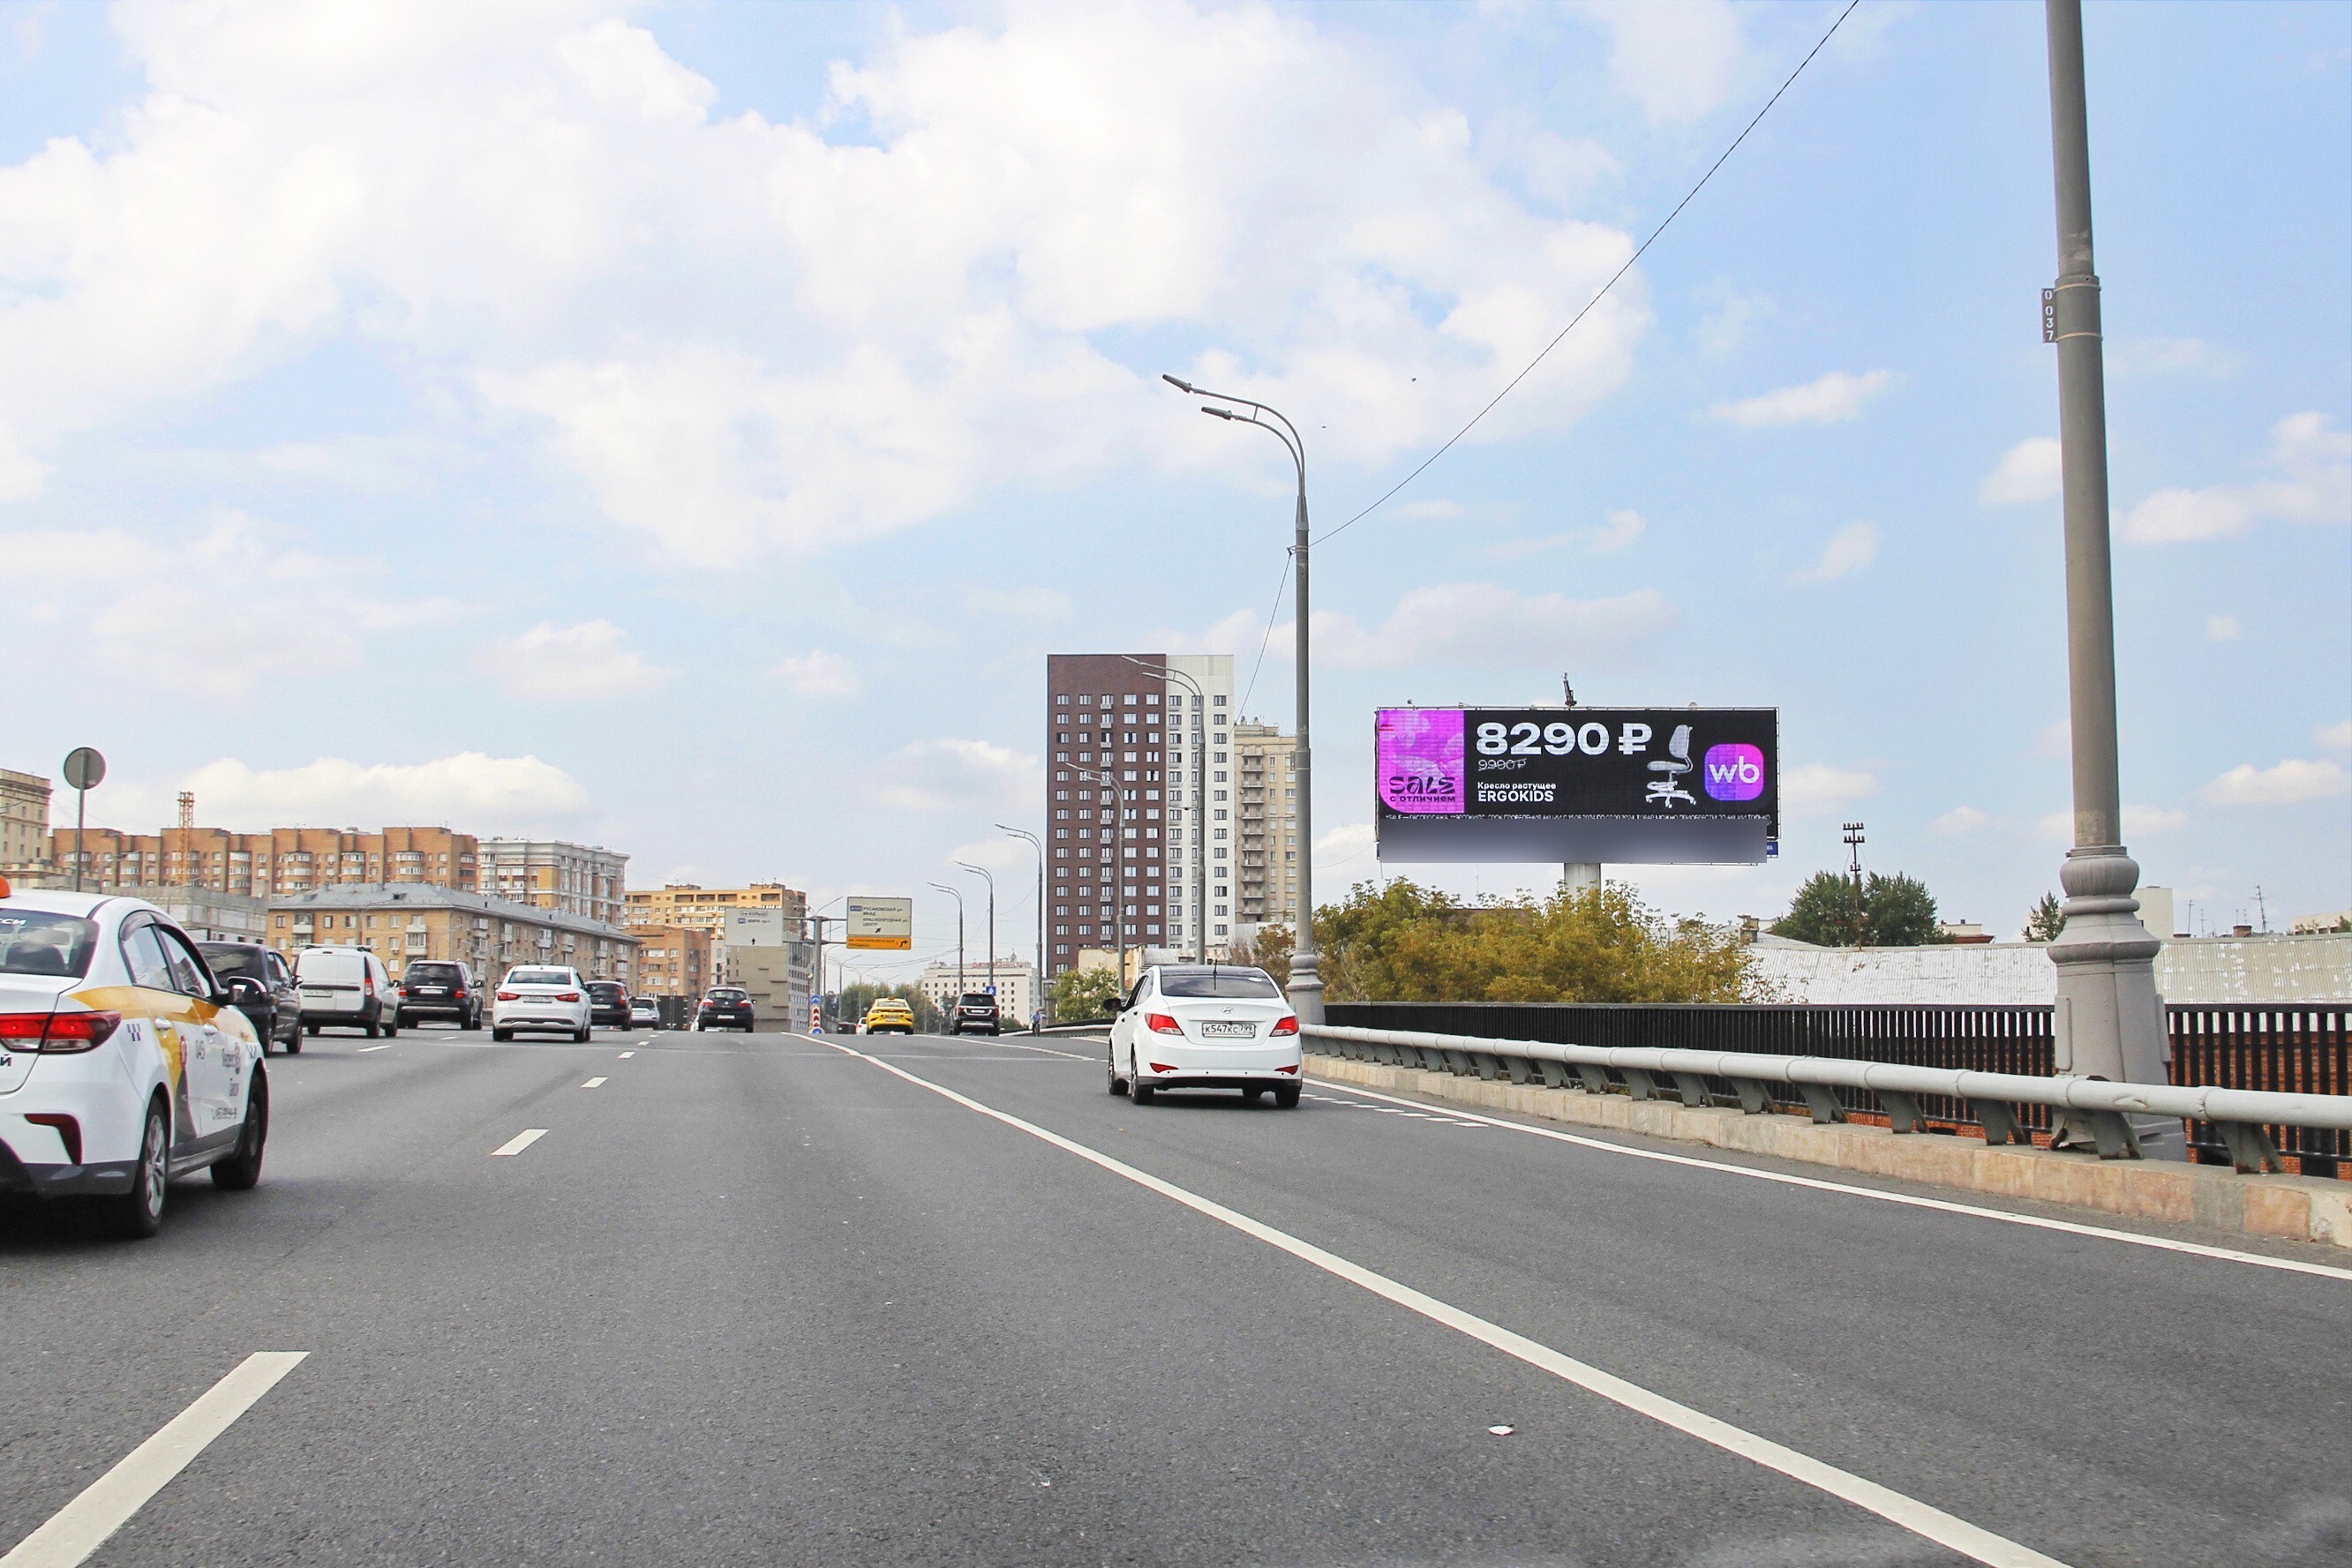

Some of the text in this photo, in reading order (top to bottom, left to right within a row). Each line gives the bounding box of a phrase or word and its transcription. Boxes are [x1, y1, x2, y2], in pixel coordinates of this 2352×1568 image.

[2044, 289, 2054, 341] 0037
[1476, 722, 1610, 756] 8290
[1709, 755, 1760, 784] wb
[1477, 790, 1554, 802] ERGOKIDS
[1512, 782, 1557, 792] растущее
